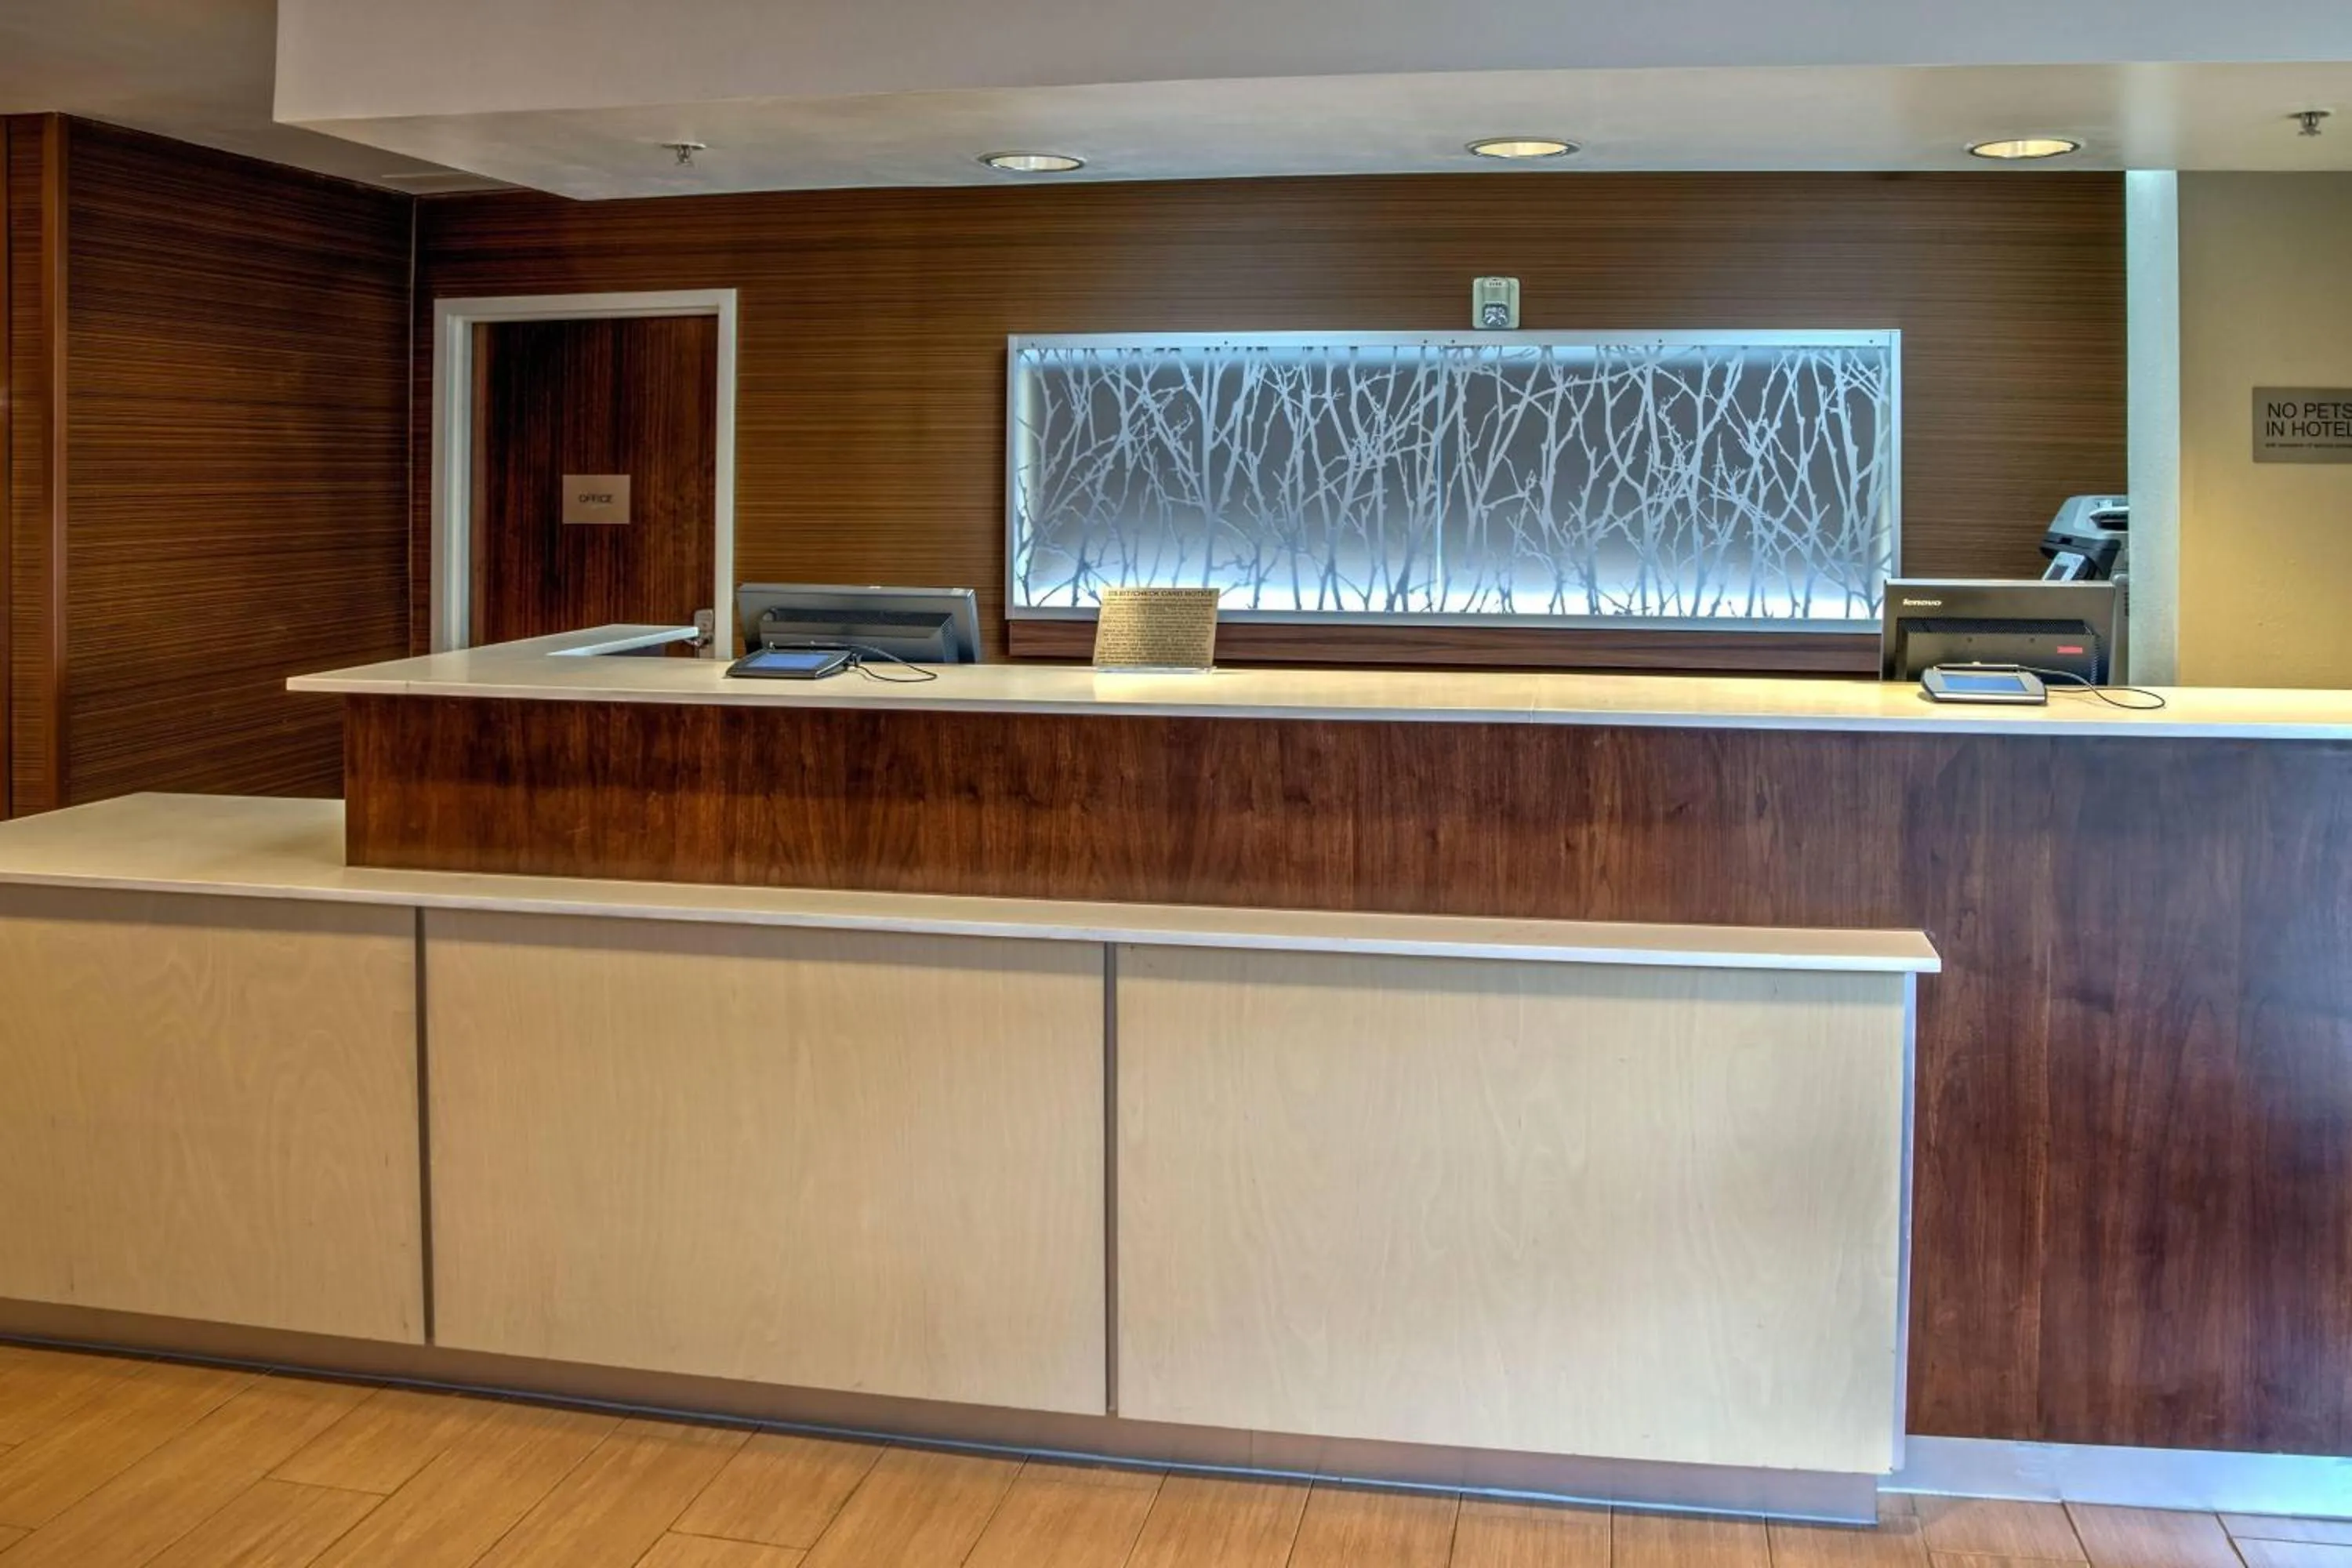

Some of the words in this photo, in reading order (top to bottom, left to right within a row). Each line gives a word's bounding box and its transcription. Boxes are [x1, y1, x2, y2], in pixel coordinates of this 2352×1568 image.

[2267, 402, 2297, 419] NO
[2303, 402, 2352, 419] PETS
[2266, 421, 2285, 437] IN
[2292, 421, 2352, 437] HOTEL
[579, 494, 613, 503] OFFICE
